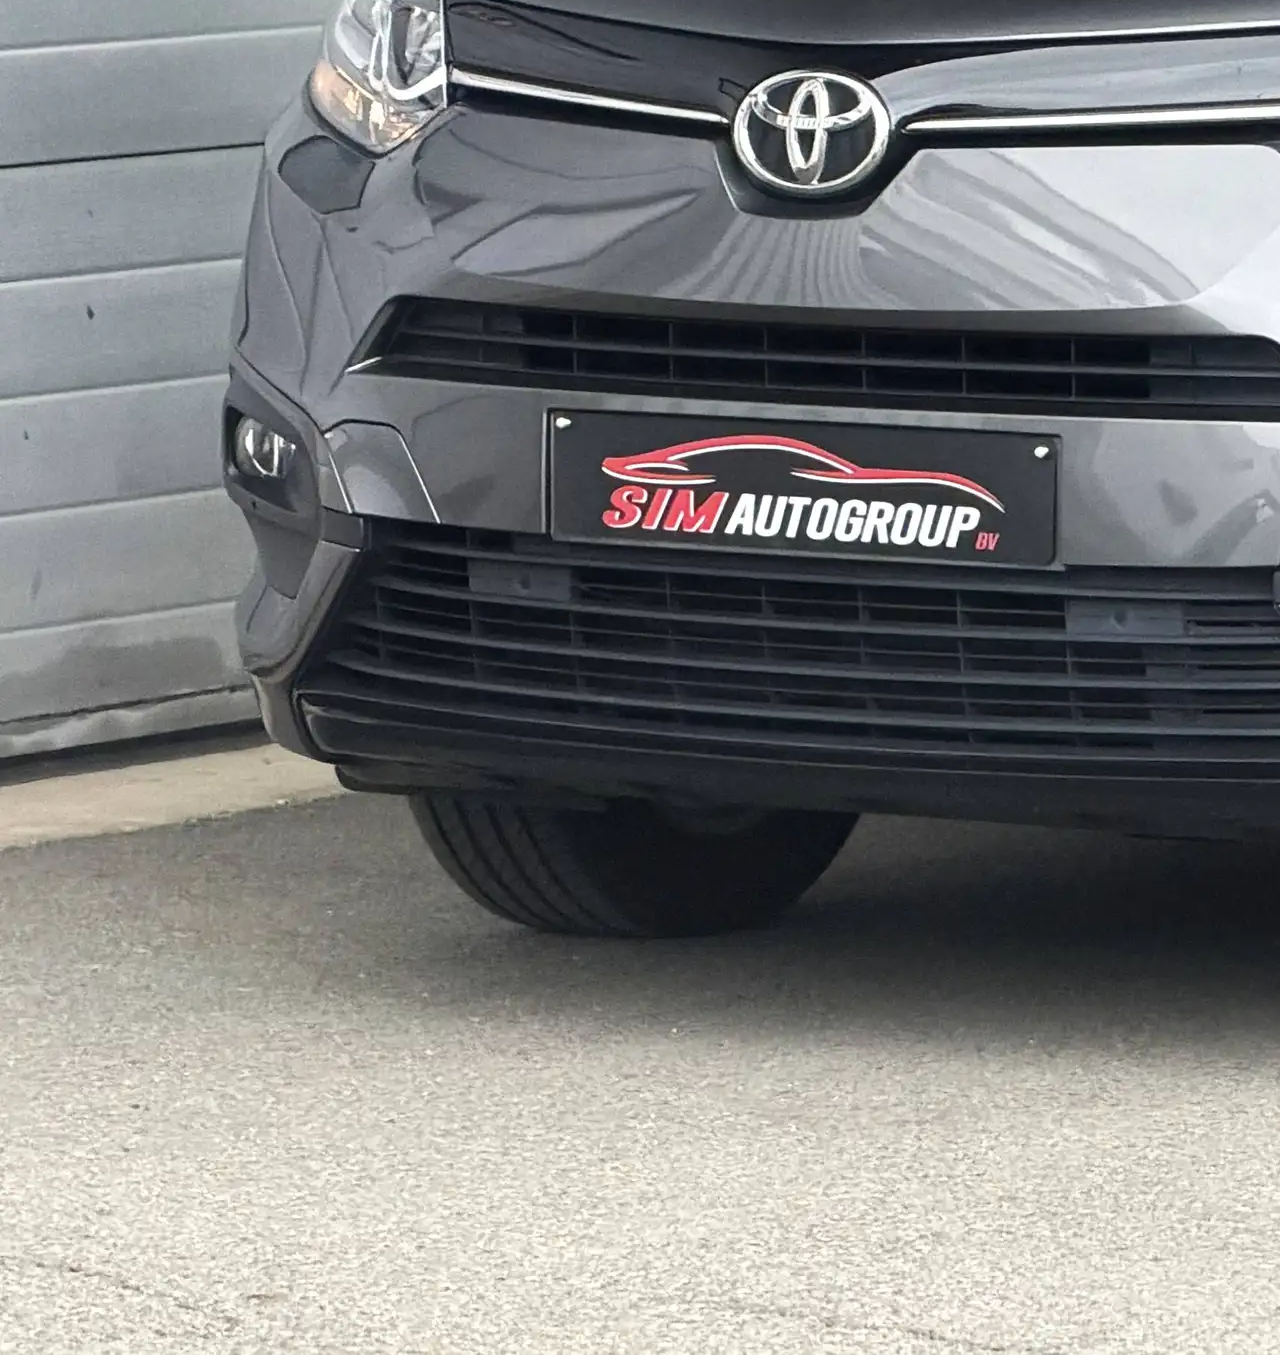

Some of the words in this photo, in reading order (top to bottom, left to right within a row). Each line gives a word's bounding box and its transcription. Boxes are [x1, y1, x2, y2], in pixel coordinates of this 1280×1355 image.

[602, 485, 729, 534] SIM
[725, 493, 981, 549] AUTOGROUP
[975, 532, 1000, 551] BV
